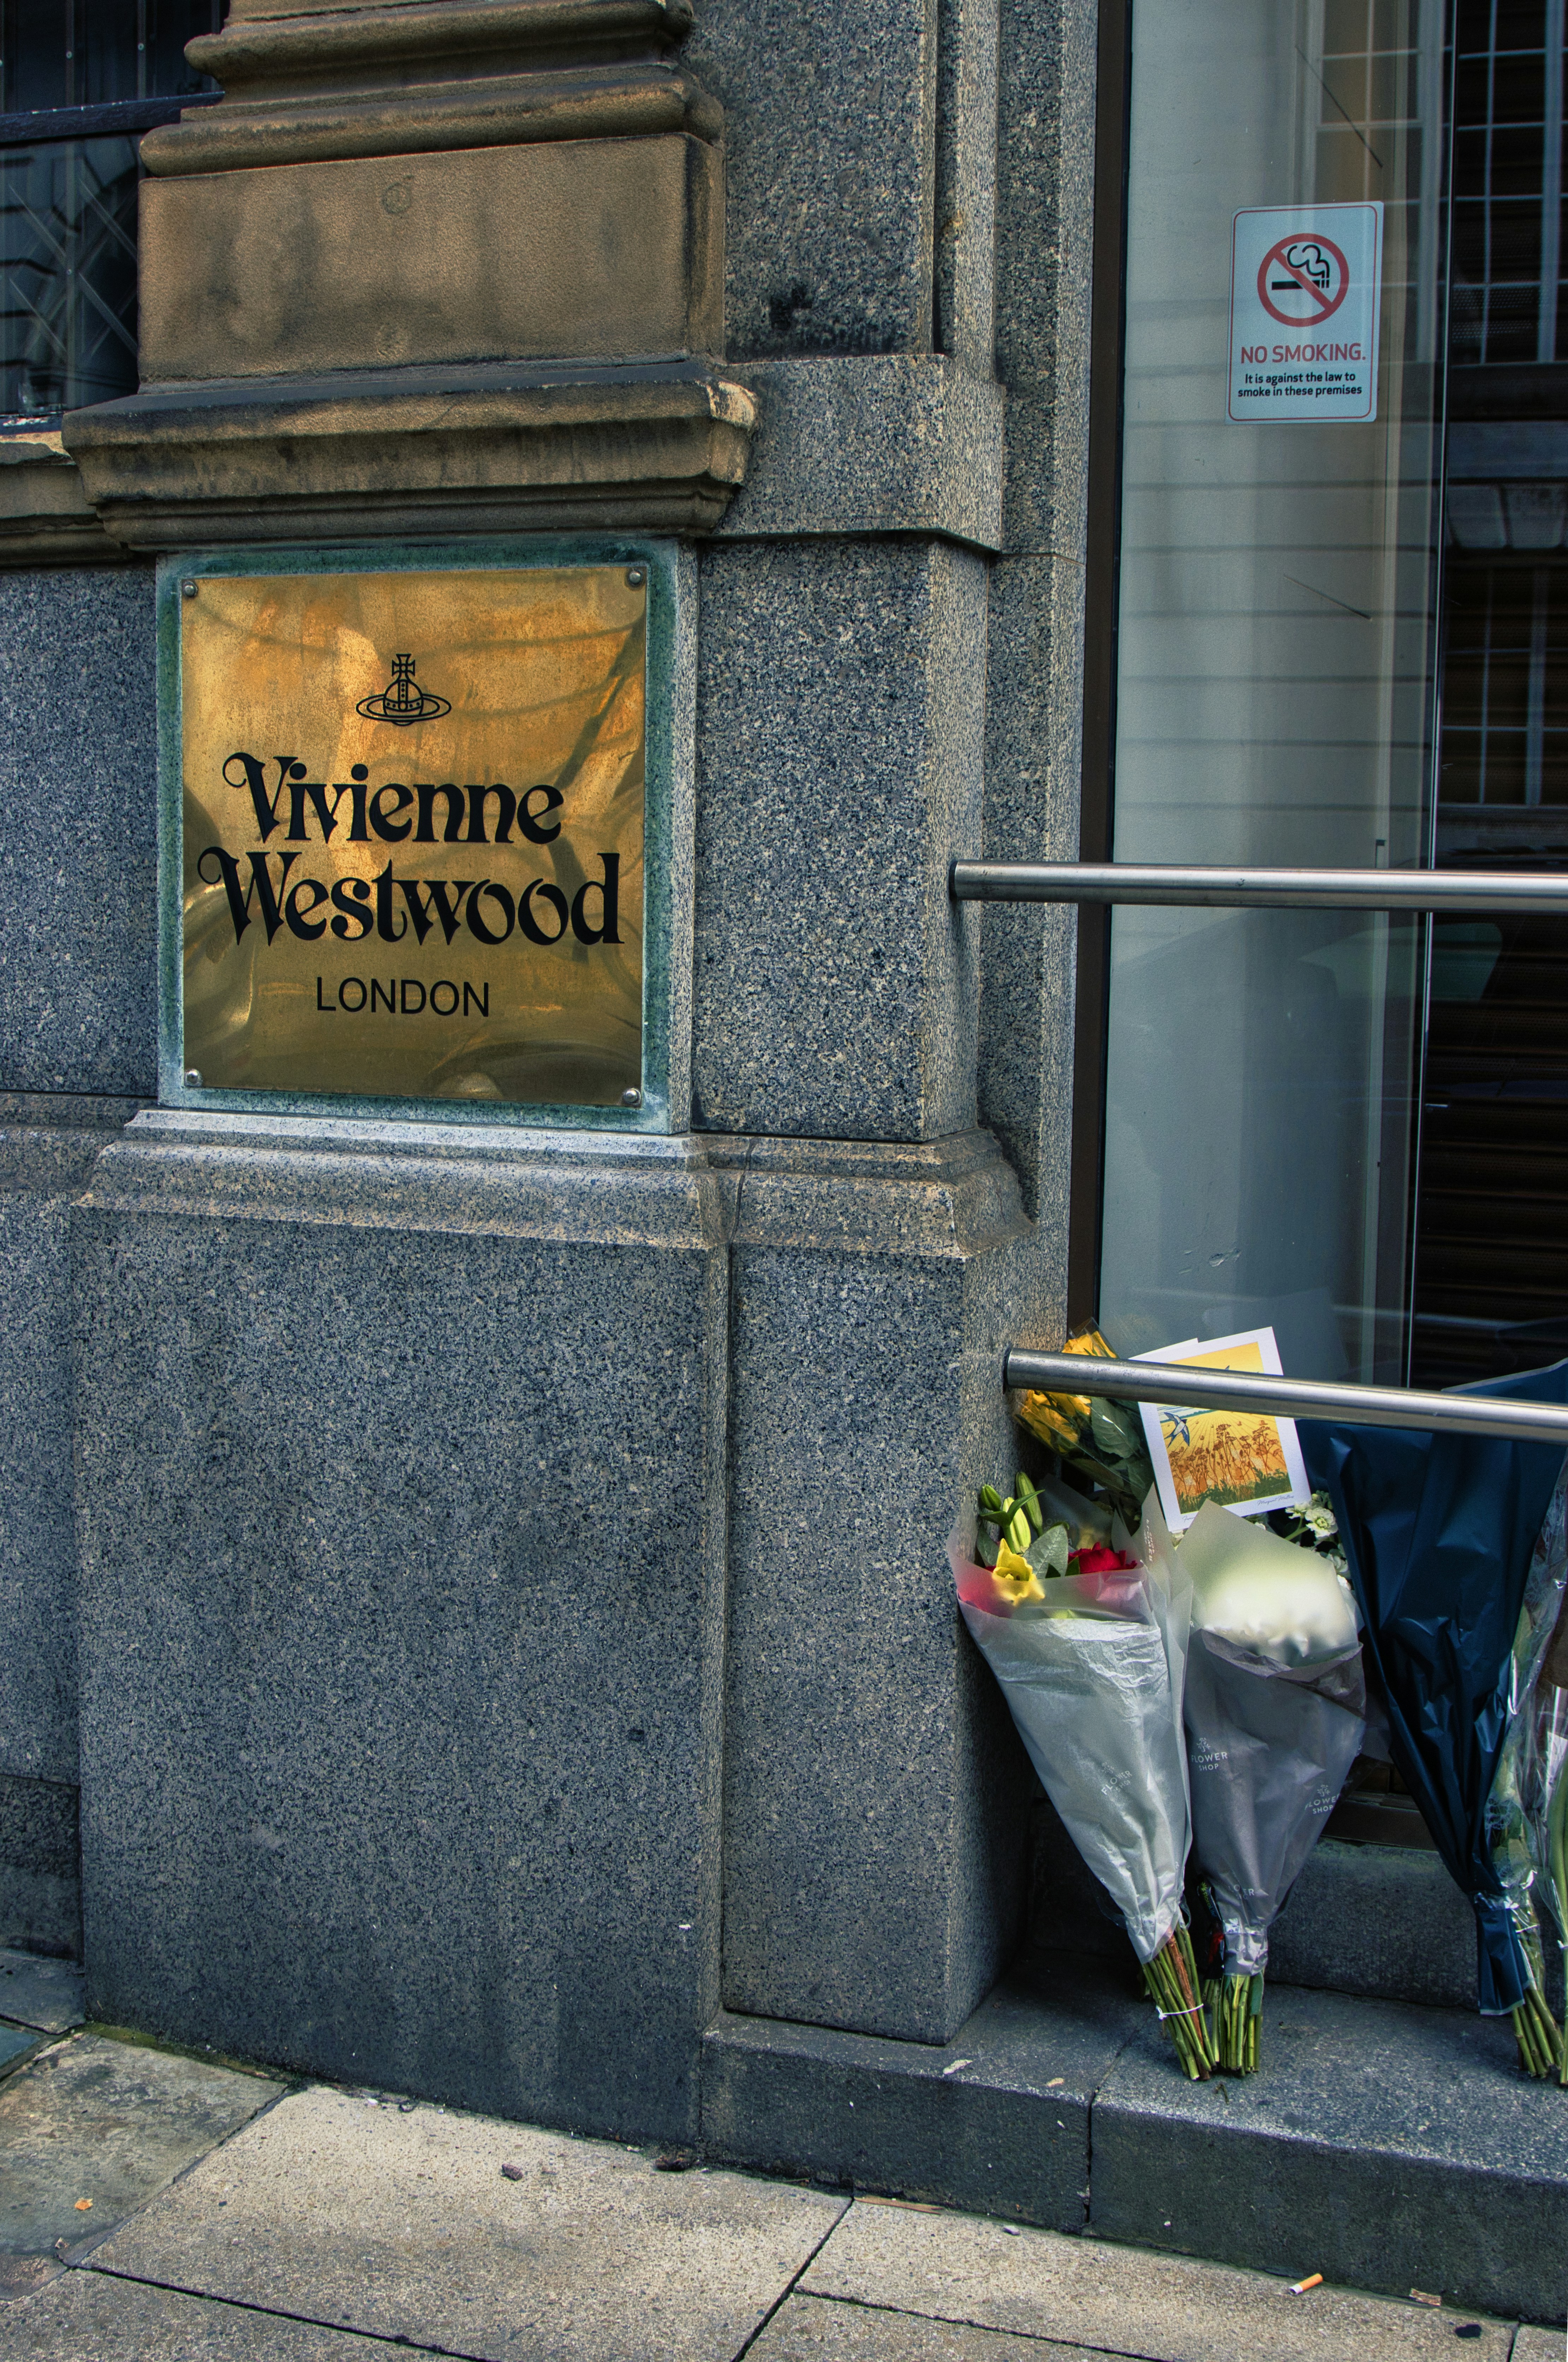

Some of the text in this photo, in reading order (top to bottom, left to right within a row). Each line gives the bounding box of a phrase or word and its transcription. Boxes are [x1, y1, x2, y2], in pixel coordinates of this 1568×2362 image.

[1241, 343, 1366, 364] NO SMOKING.
[1245, 372, 1355, 385] It is against the law to
[1238, 385, 1362, 398] smoke in these premises
[222, 752, 564, 844] Vivienne
[197, 847, 625, 946] Westwood
[316, 977, 490, 1017] LONDON
[1191, 1752, 1228, 1763] FLOWER
[1101, 1770, 1132, 1795] FLOWER
[1312, 1805, 1333, 1814] SHOP
